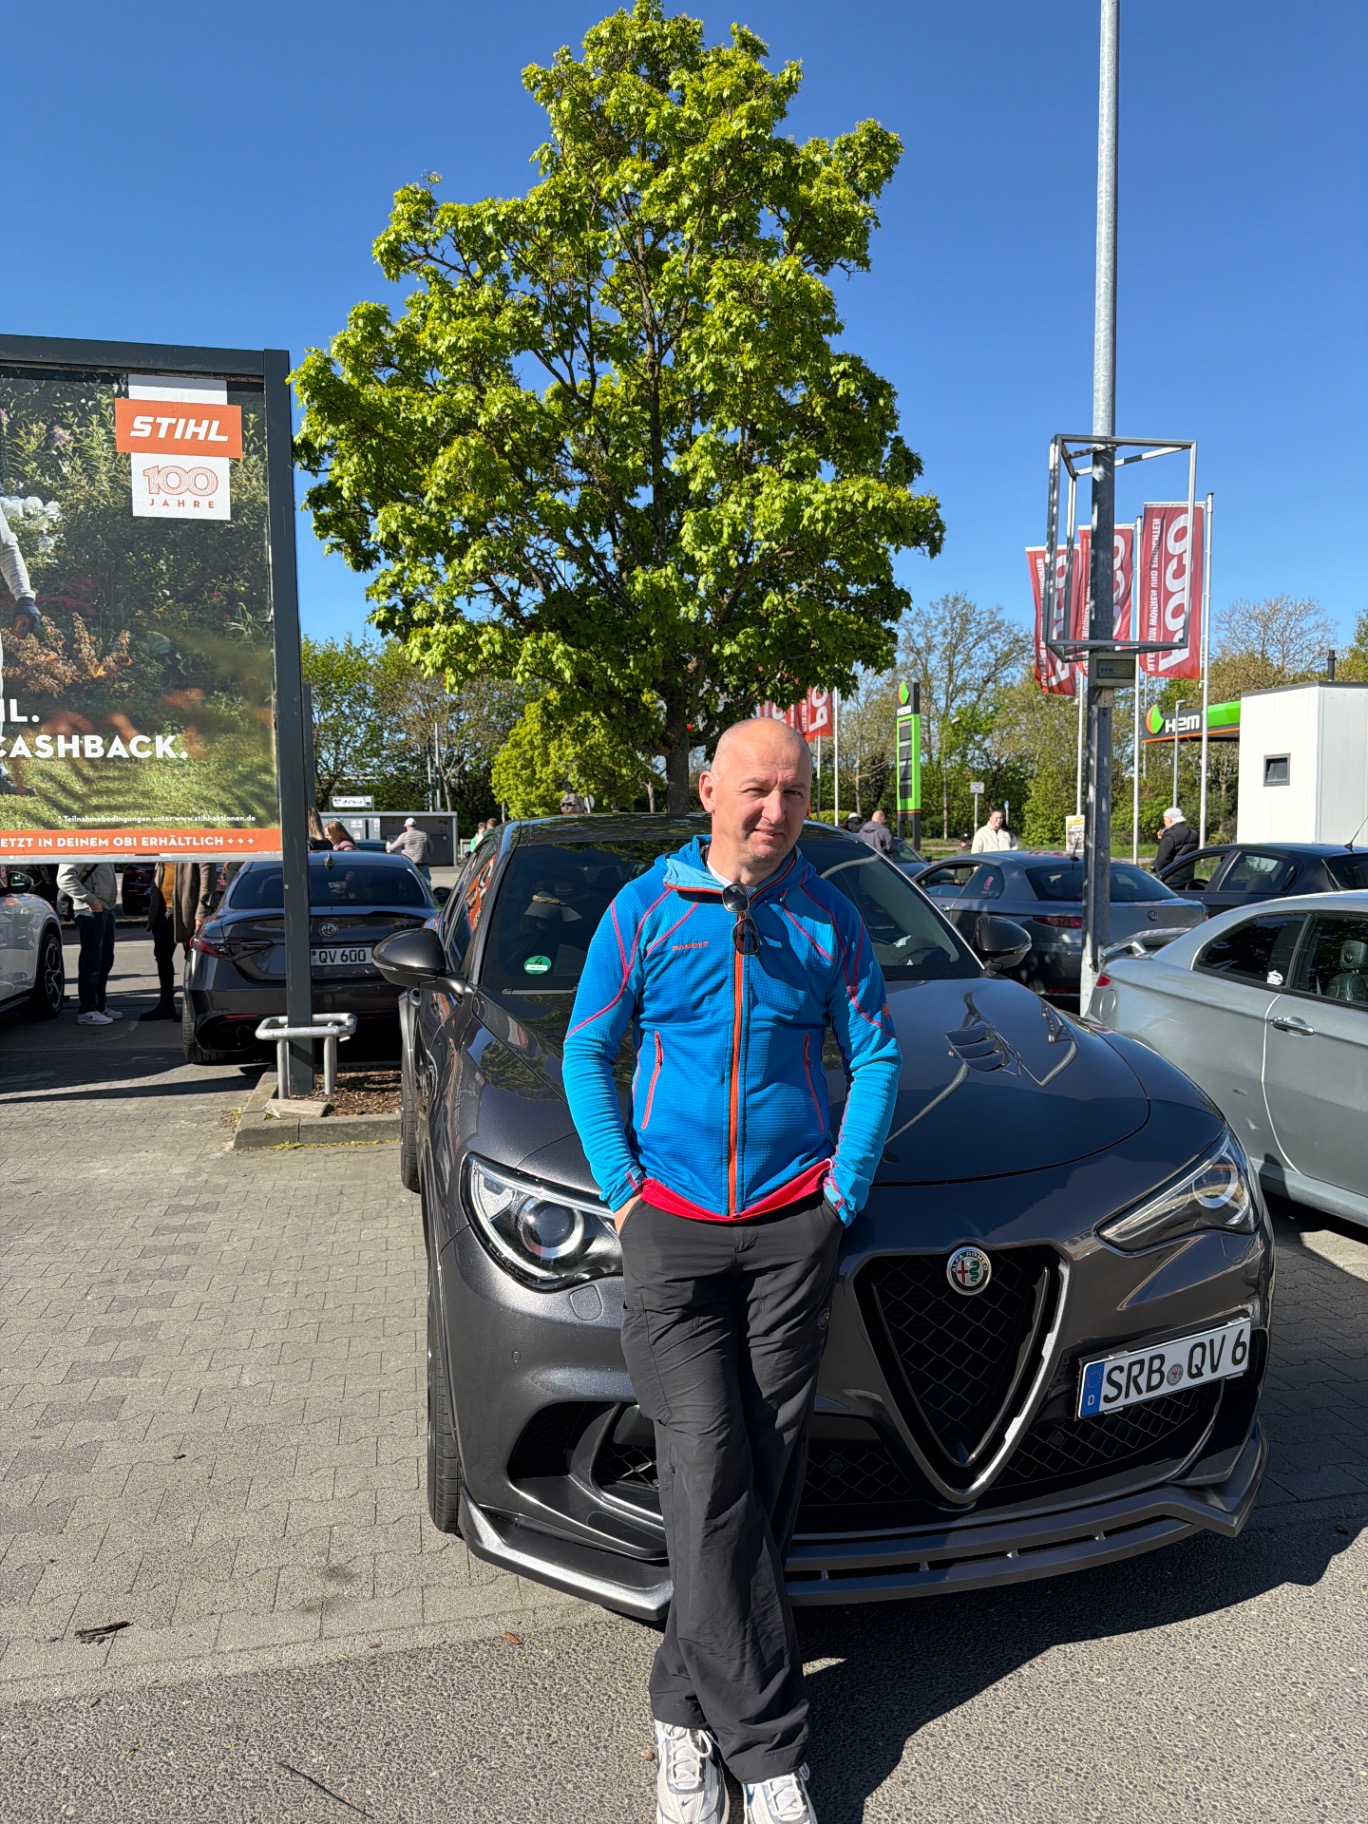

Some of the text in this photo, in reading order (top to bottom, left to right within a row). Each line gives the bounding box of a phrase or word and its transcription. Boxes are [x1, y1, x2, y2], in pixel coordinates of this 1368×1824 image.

[129, 416, 229, 442] STIHL
[143, 465, 219, 497] 100
[149, 499, 215, 509] JAHRE
[62, 814, 151, 824] Teilnahmebedingungen
[38, 837, 53, 848] IN
[57, 837, 109, 847] DEINEM
[113, 836, 137, 847] OBI
[141, 834, 224, 847] ERHÄLTLICH
[319, 949, 366, 963] QV 600
[1103, 1328, 1247, 1404] SRB QV 6
[1087, 1394, 1095, 1406] D
